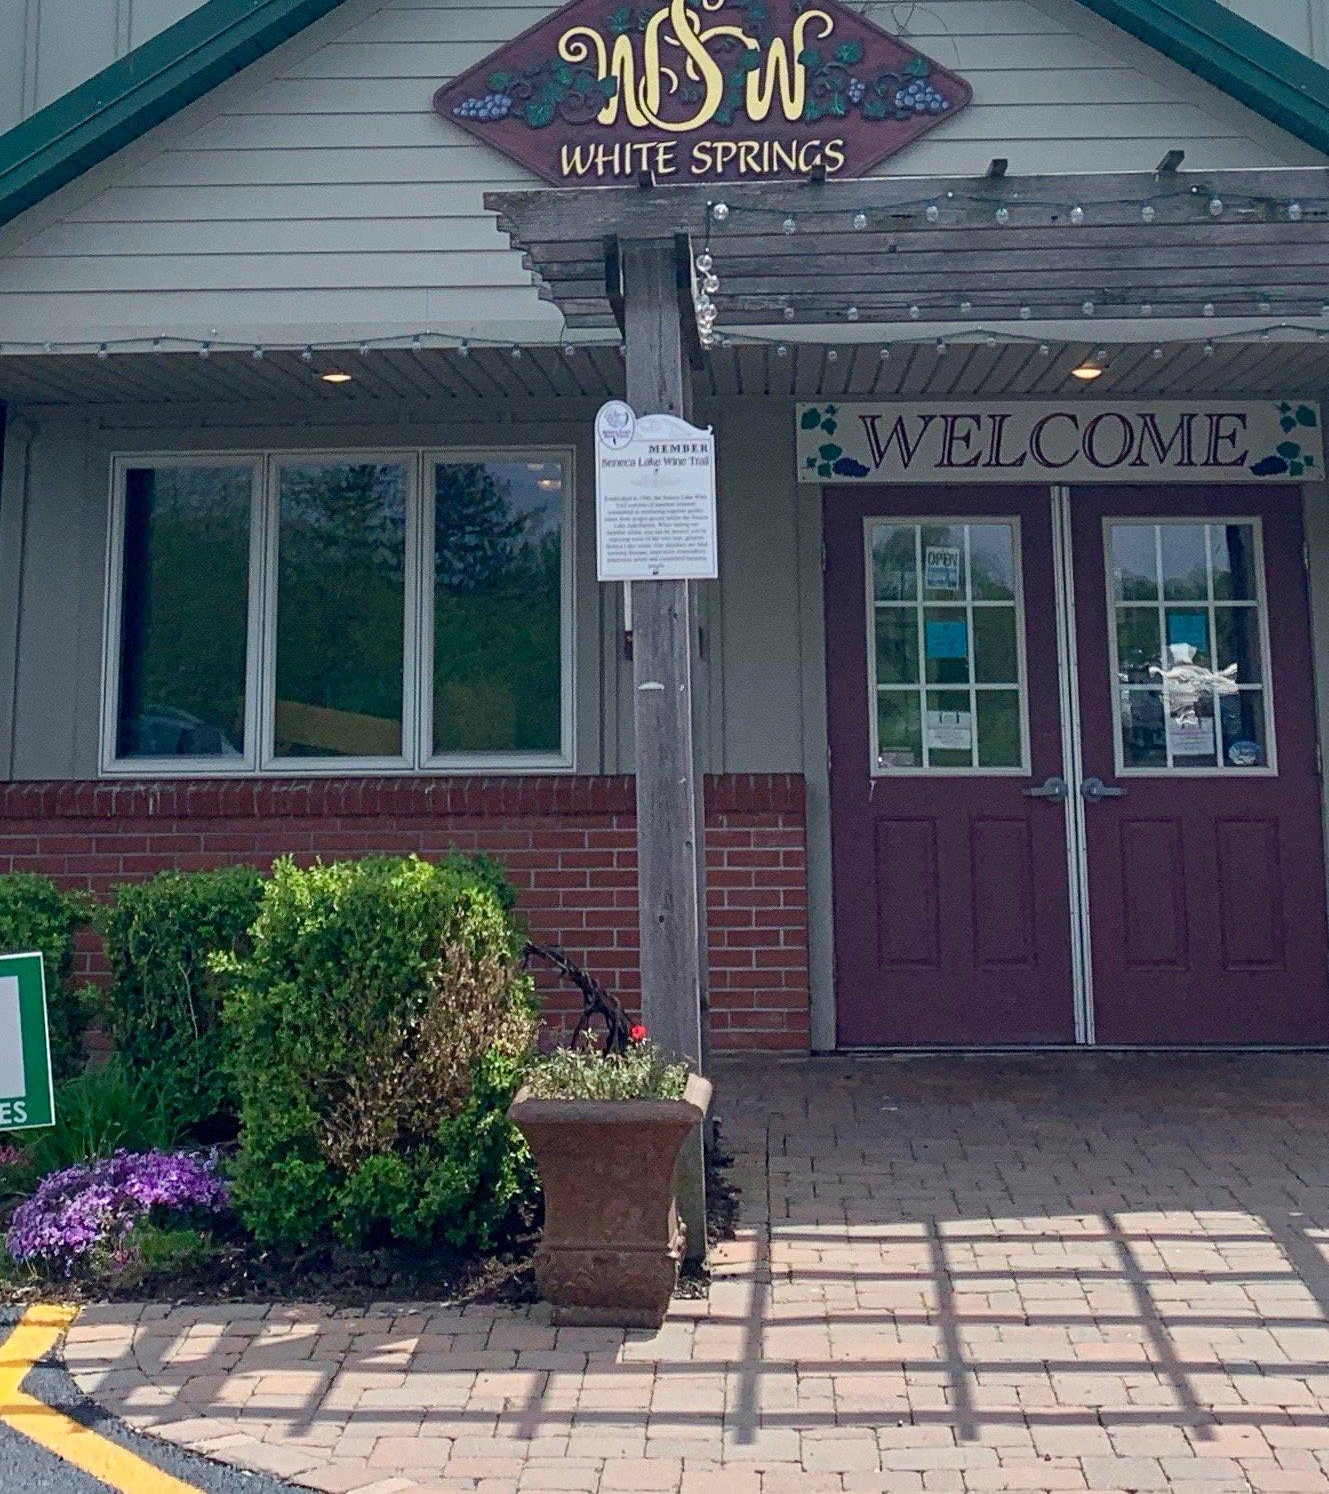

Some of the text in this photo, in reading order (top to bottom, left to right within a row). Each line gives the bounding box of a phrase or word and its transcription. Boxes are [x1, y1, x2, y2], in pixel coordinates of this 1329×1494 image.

[560, 138, 845, 176] WHITE SPRINGS
[648, 444, 709, 454] MEMBER
[858, 412, 1250, 470] WELCOME
[601, 456, 710, 469] Seneca Lake Wine Trail
[928, 551, 958, 567] OPEN
